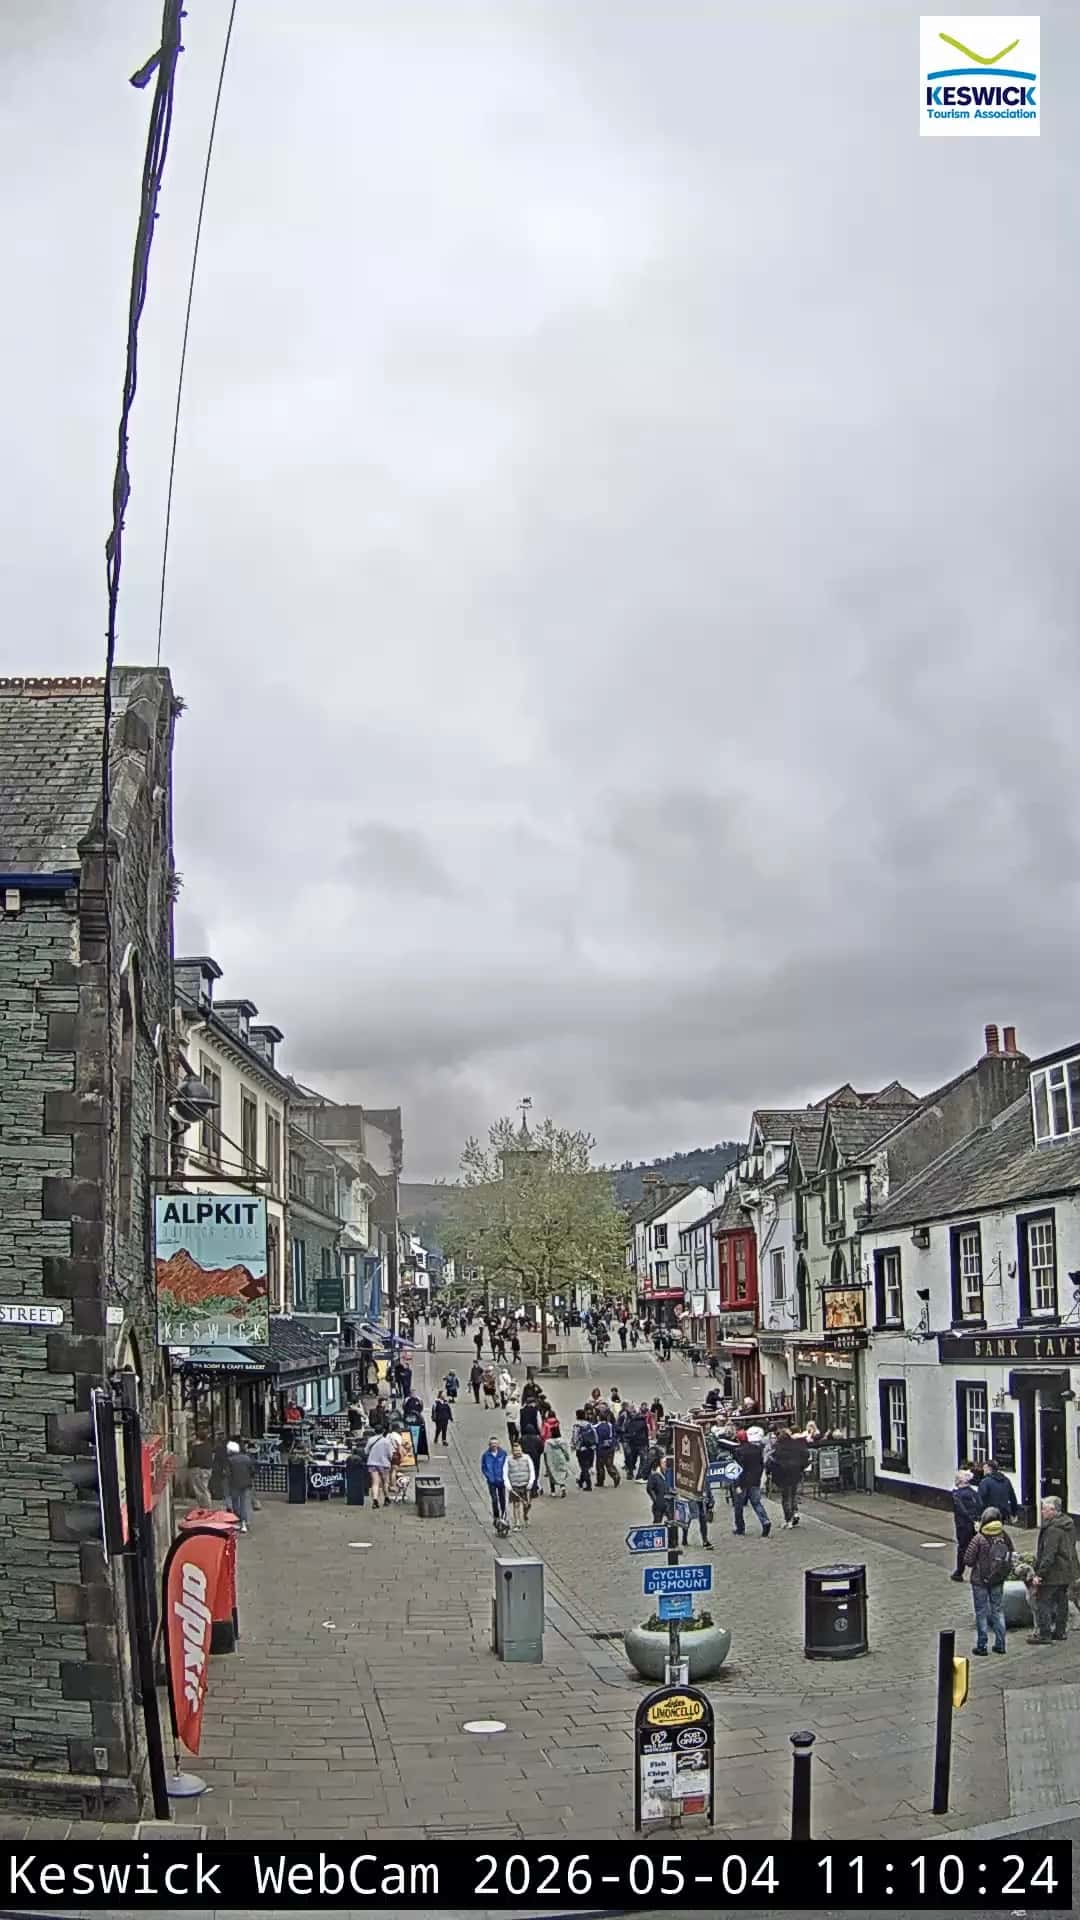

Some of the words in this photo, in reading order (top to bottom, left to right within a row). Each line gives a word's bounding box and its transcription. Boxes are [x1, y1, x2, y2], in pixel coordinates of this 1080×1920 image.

[163, 1203, 259, 1225] ALPKIT
[164, 1321, 261, 1341] KESWICK
[974, 1339, 1018, 1357] BANK
[651, 1568, 704, 1580] CYCLISTS
[648, 1578, 708, 1590] DISMOUNT
[652, 1703, 700, 1720] LIMONCELLO
